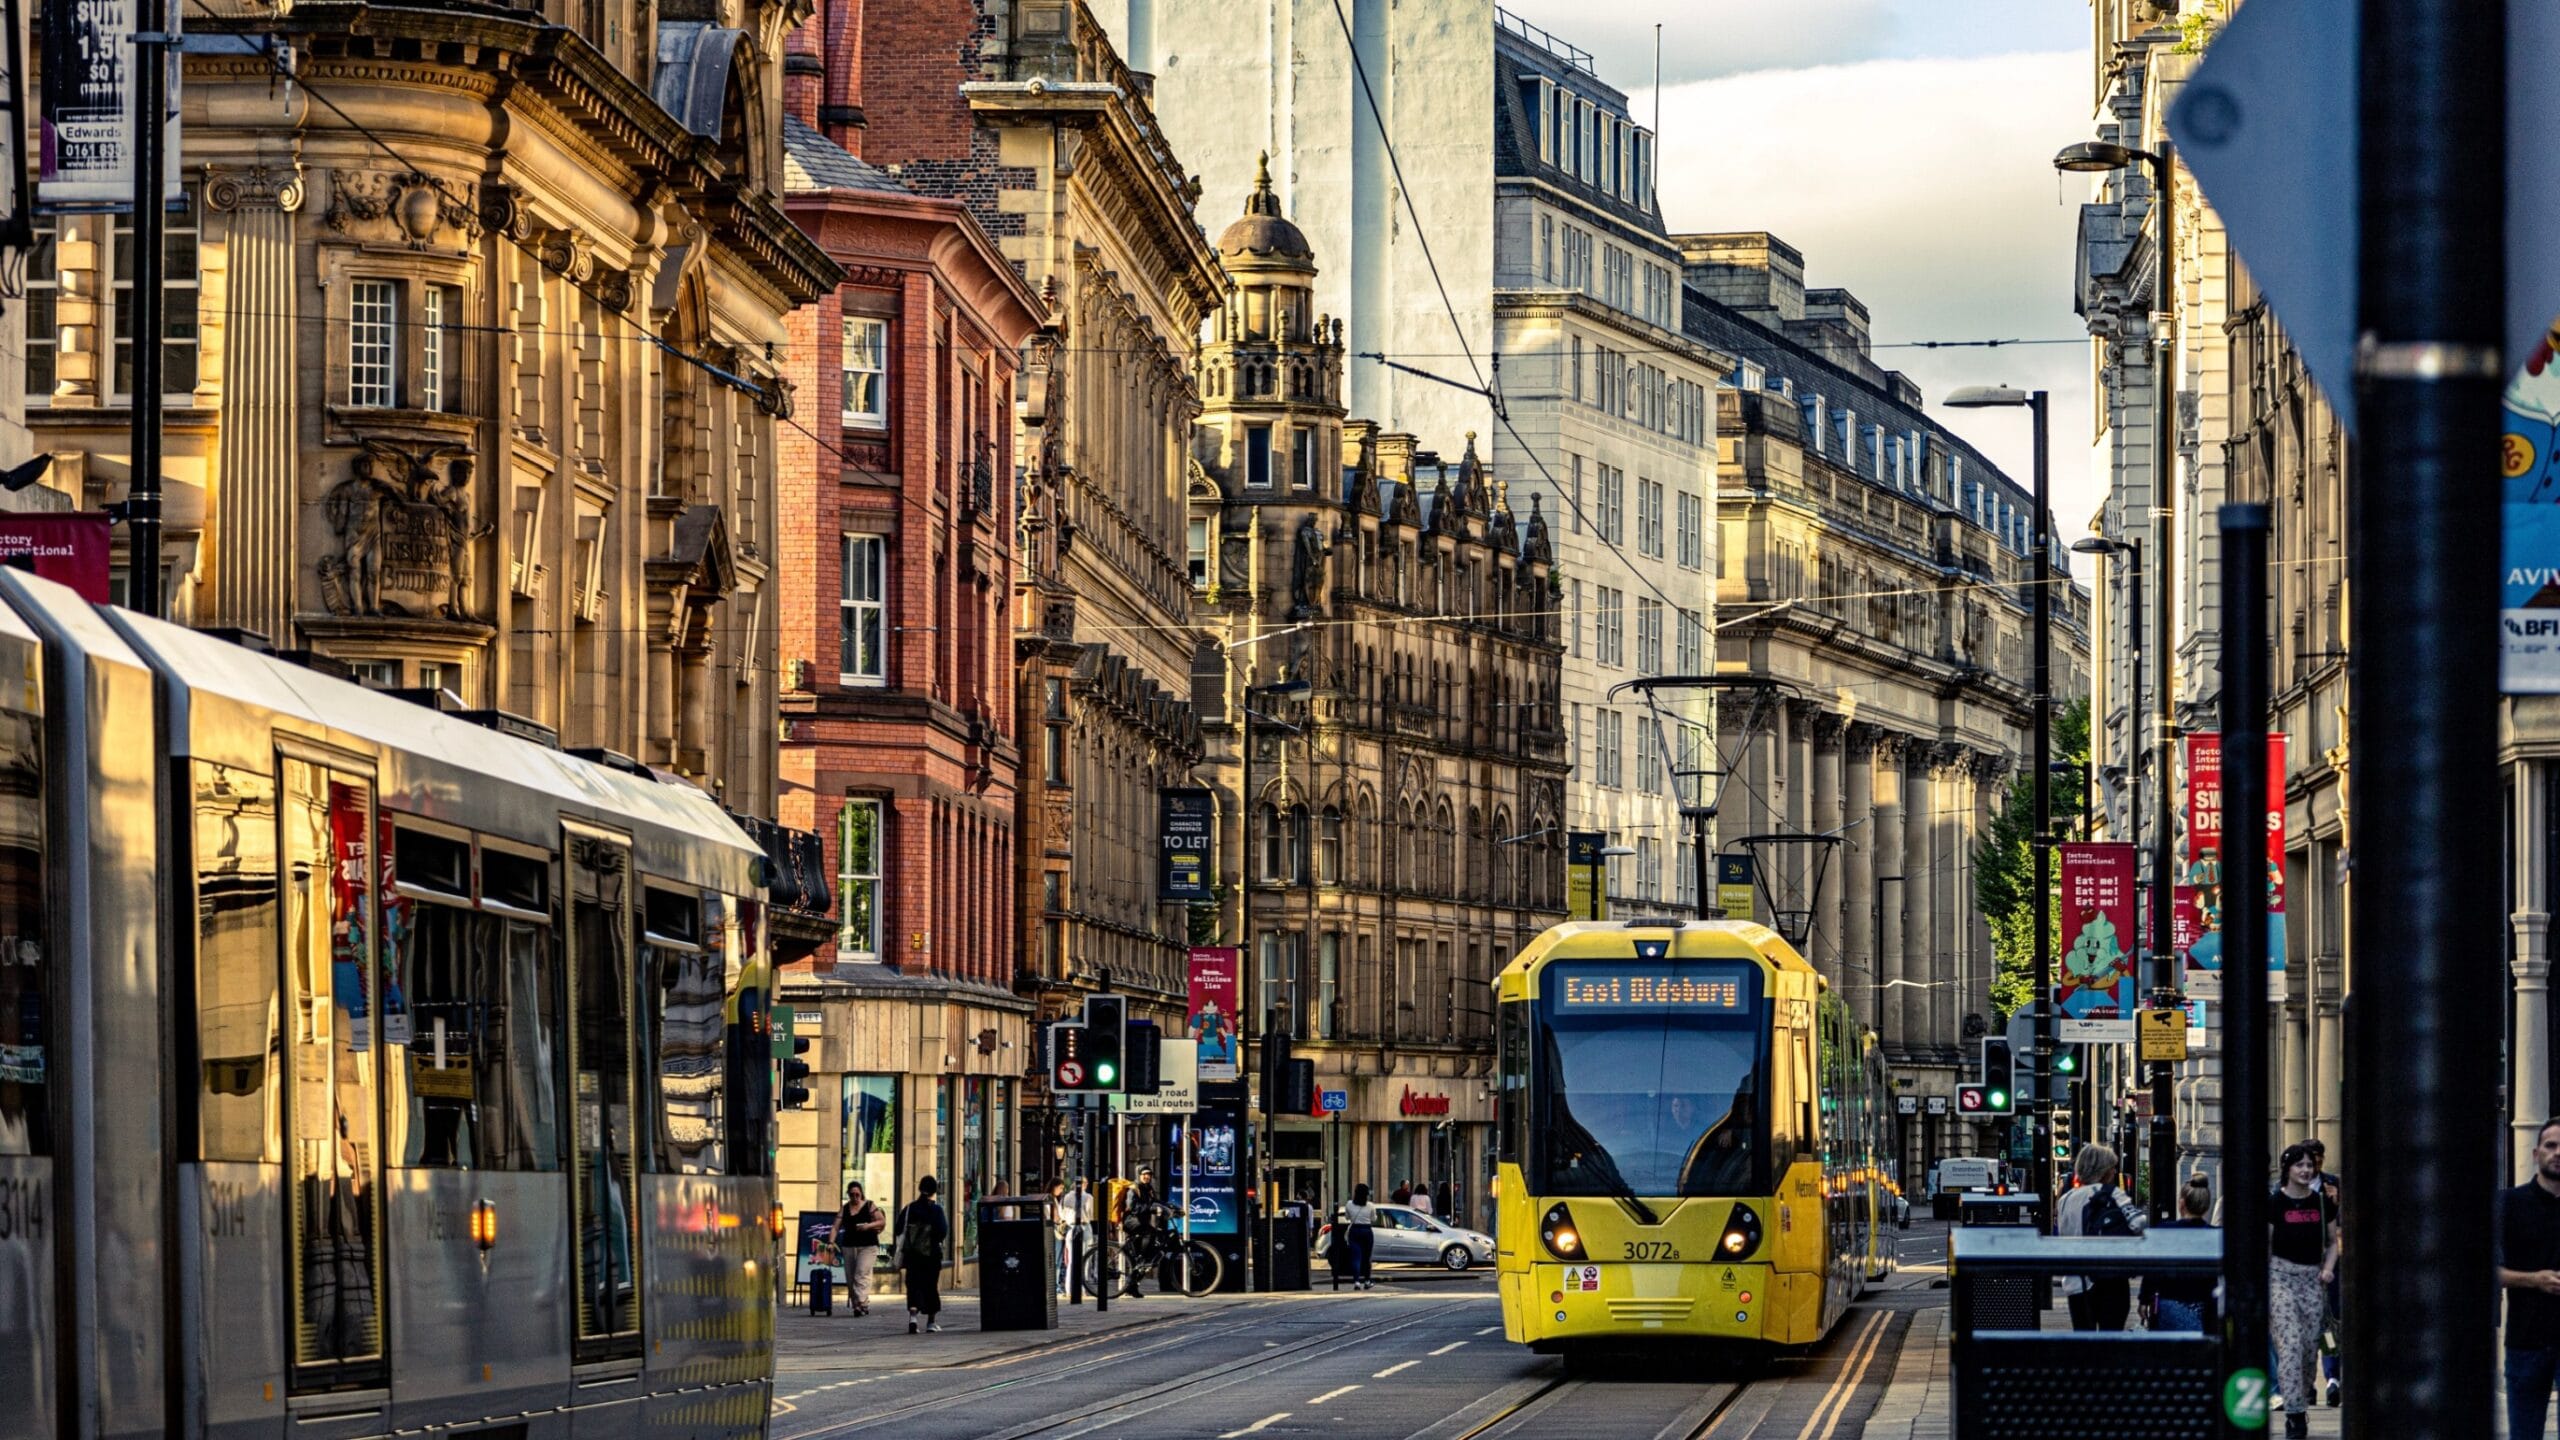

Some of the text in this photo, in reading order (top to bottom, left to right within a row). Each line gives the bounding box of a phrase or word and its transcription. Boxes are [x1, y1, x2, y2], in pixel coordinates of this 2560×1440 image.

[89, 64, 109, 81] SQ
[65, 127, 121, 138] Edwards
[66, 144, 94, 156] 0161
[2525, 619, 2559, 636] BFI
[2195, 811, 2282, 831] DRS
[1163, 836, 1209, 849] TO LET
[1728, 863, 1743, 875] 26
[2075, 876, 2119, 885] Eat me!
[2075, 887, 2119, 896] Eat me!
[2075, 897, 2119, 906] Eat me!
[1204, 982, 1222, 990] lies
[1567, 977, 1621, 1003] East
[773, 1033, 788, 1042] ET
[1165, 1089, 1188, 1097] road
[1133, 1099, 1144, 1107] to
[1147, 1098, 1160, 1107] all
[1162, 1099, 1194, 1108] routes
[0, 1178, 43, 1240] 3114
[210, 1180, 246, 1237] 3114
